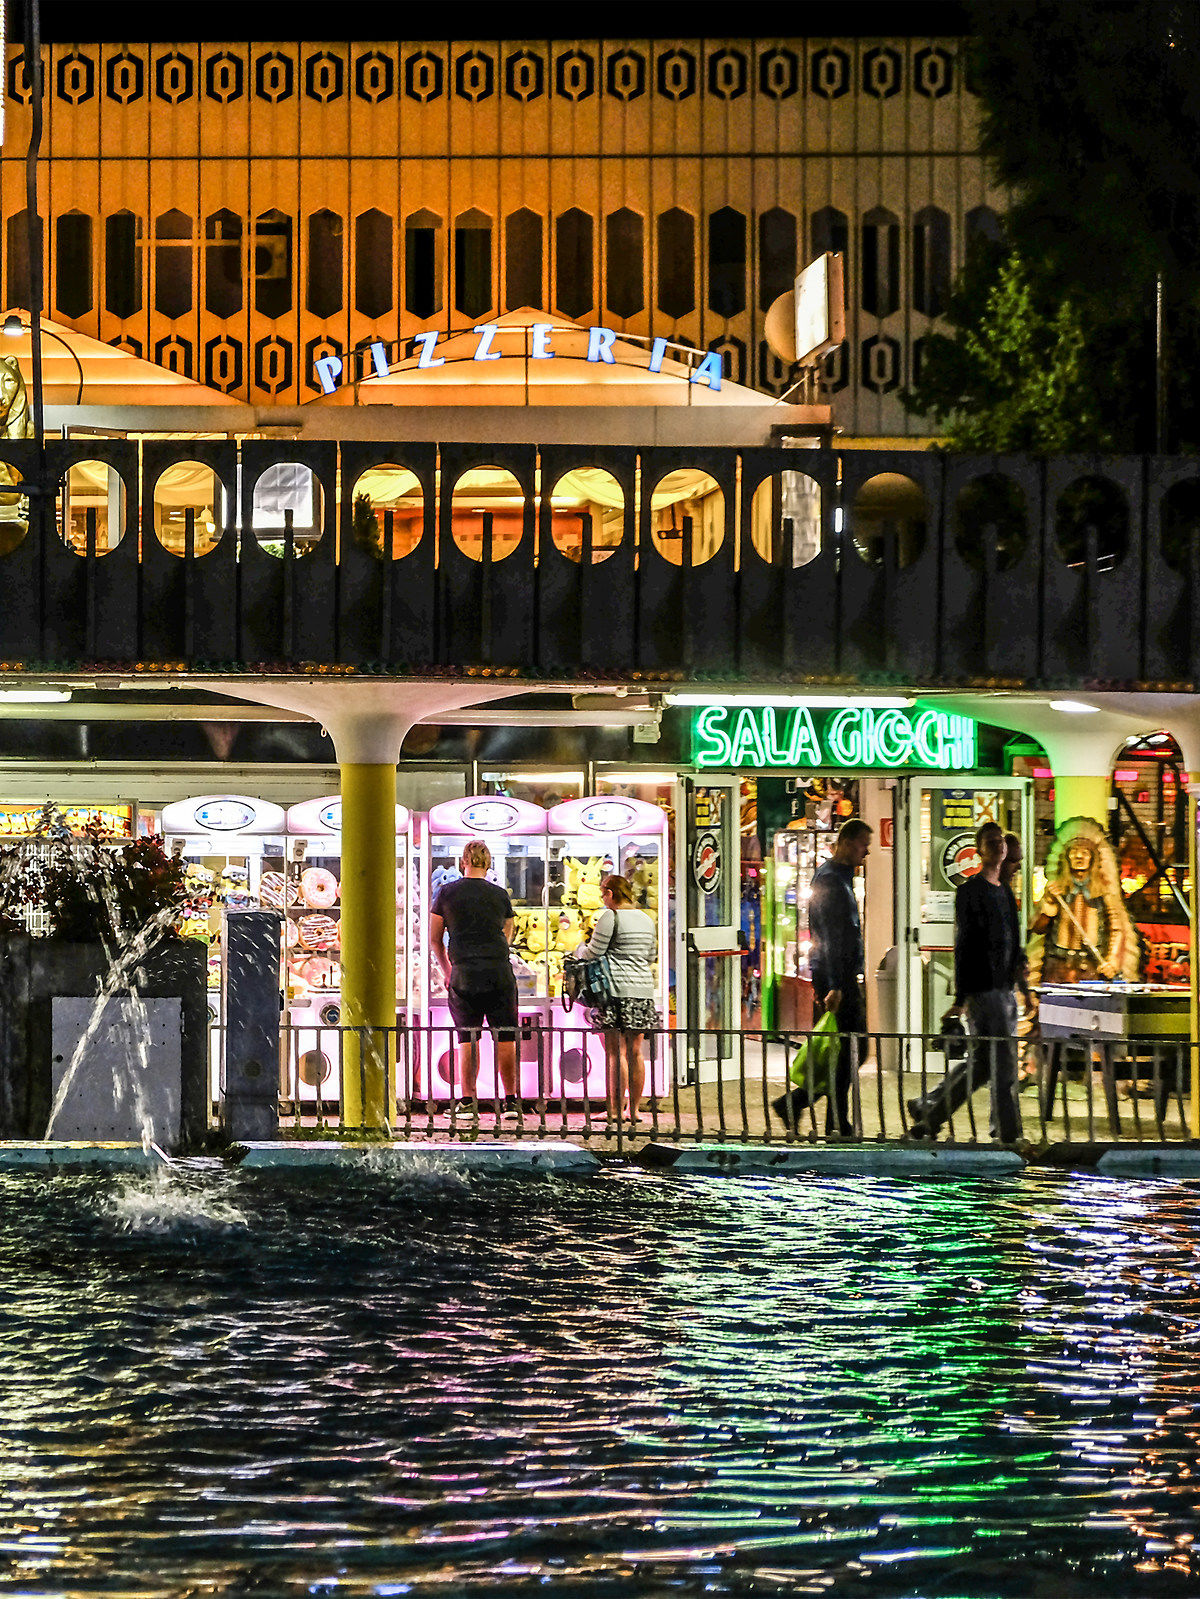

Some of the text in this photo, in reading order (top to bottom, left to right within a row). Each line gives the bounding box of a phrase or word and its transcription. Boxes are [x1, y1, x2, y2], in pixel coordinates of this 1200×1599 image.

[314, 323, 723, 393] PIZZERIA
[696, 706, 975, 769] SALA GIOCHI
